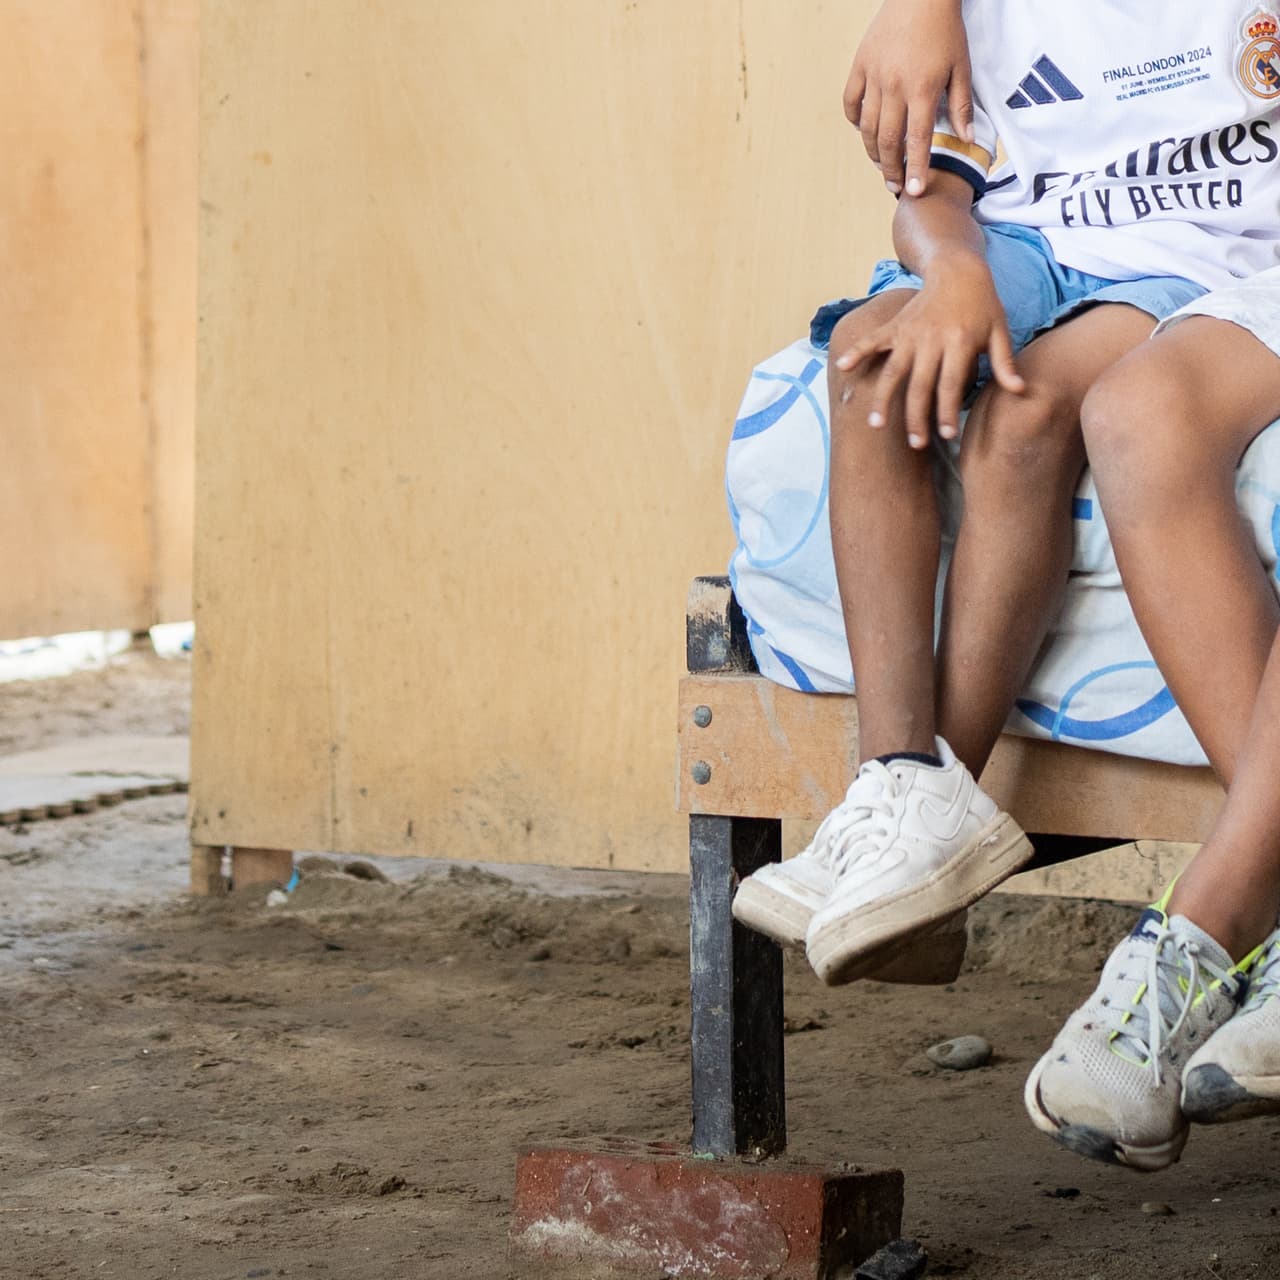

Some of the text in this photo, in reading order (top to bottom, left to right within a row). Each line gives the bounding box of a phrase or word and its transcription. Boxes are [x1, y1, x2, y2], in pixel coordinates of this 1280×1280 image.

[1103, 45, 1212, 83] FINAL LONDON 2024
